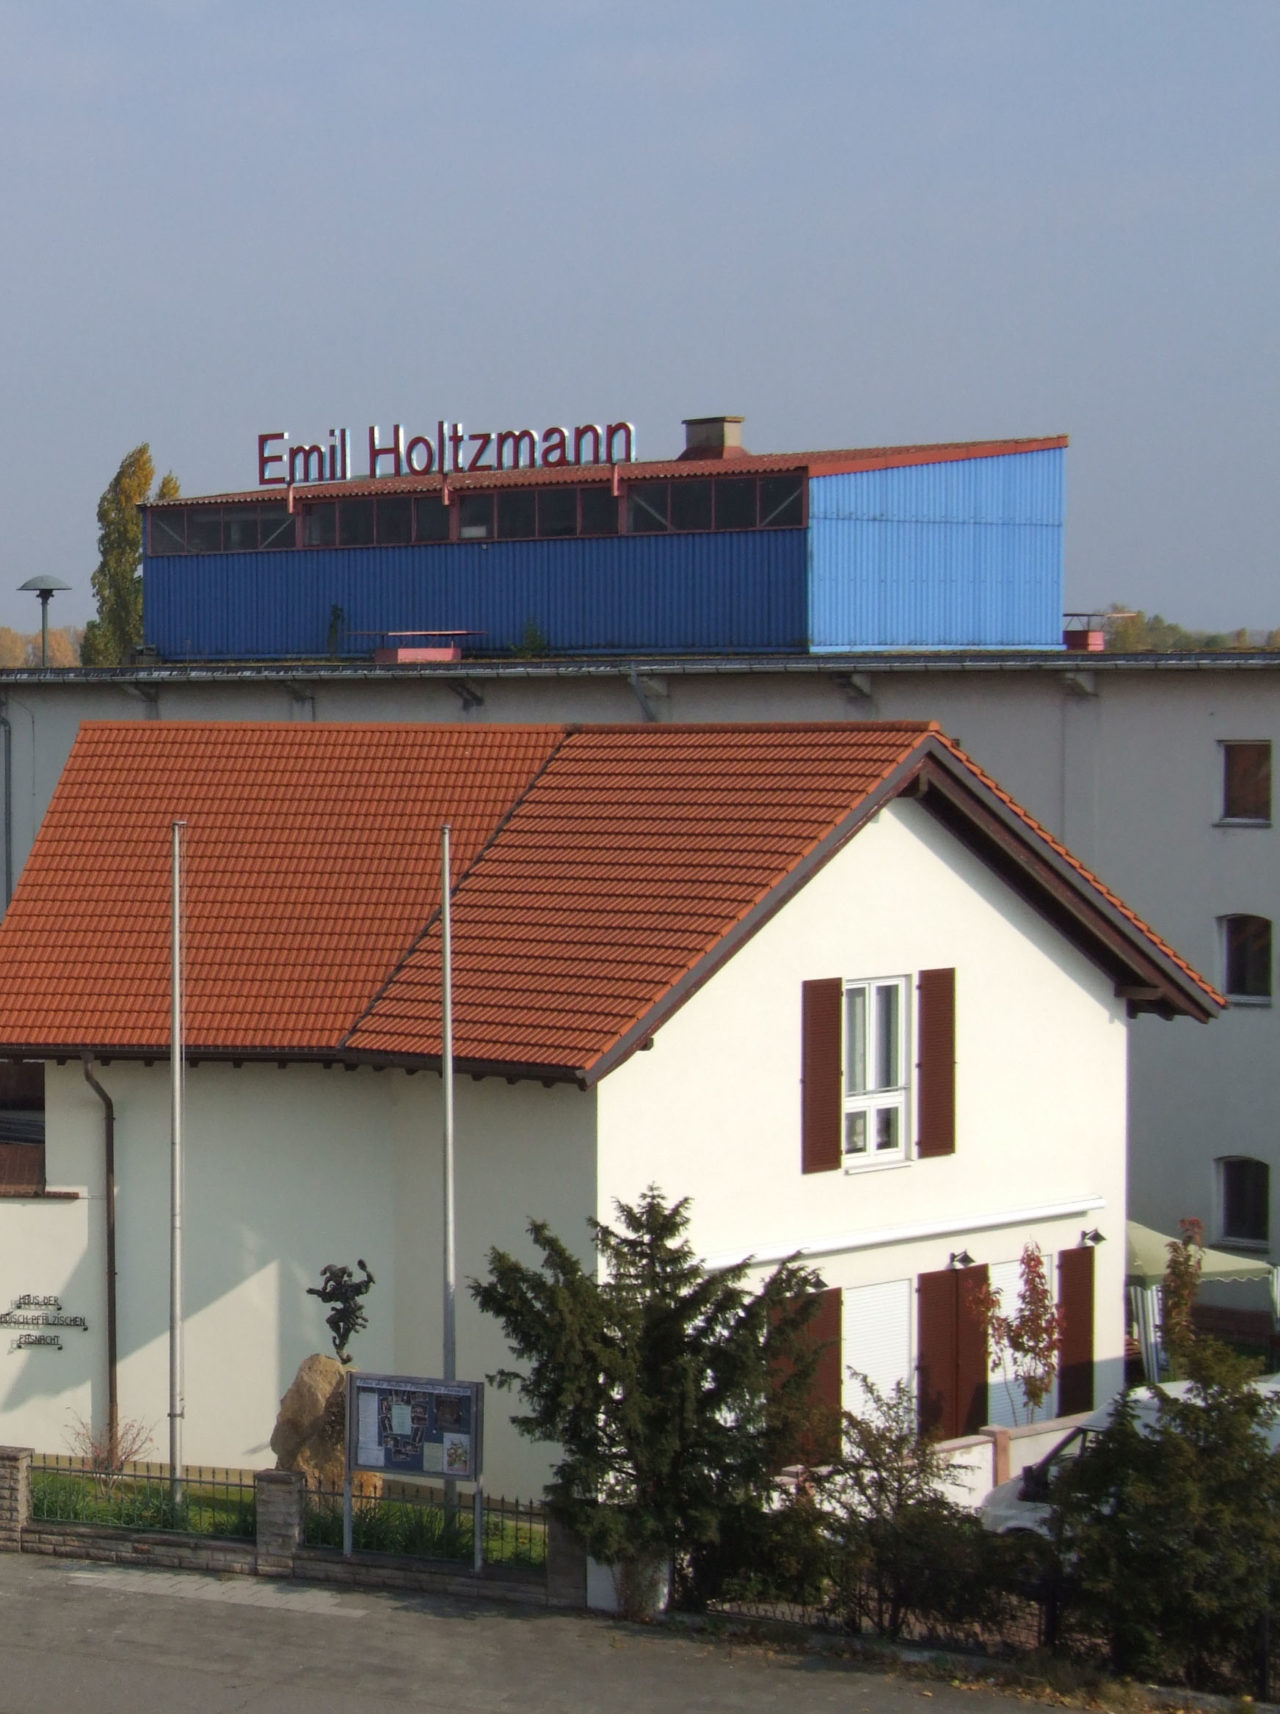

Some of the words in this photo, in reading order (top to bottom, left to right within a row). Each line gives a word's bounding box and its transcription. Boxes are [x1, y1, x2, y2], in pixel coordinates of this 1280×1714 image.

[258, 428, 350, 486] Emil
[369, 420, 636, 478] Holtzmann
[18, 1295, 40, 1306] HAUS
[42, 1296, 60, 1307] DER
